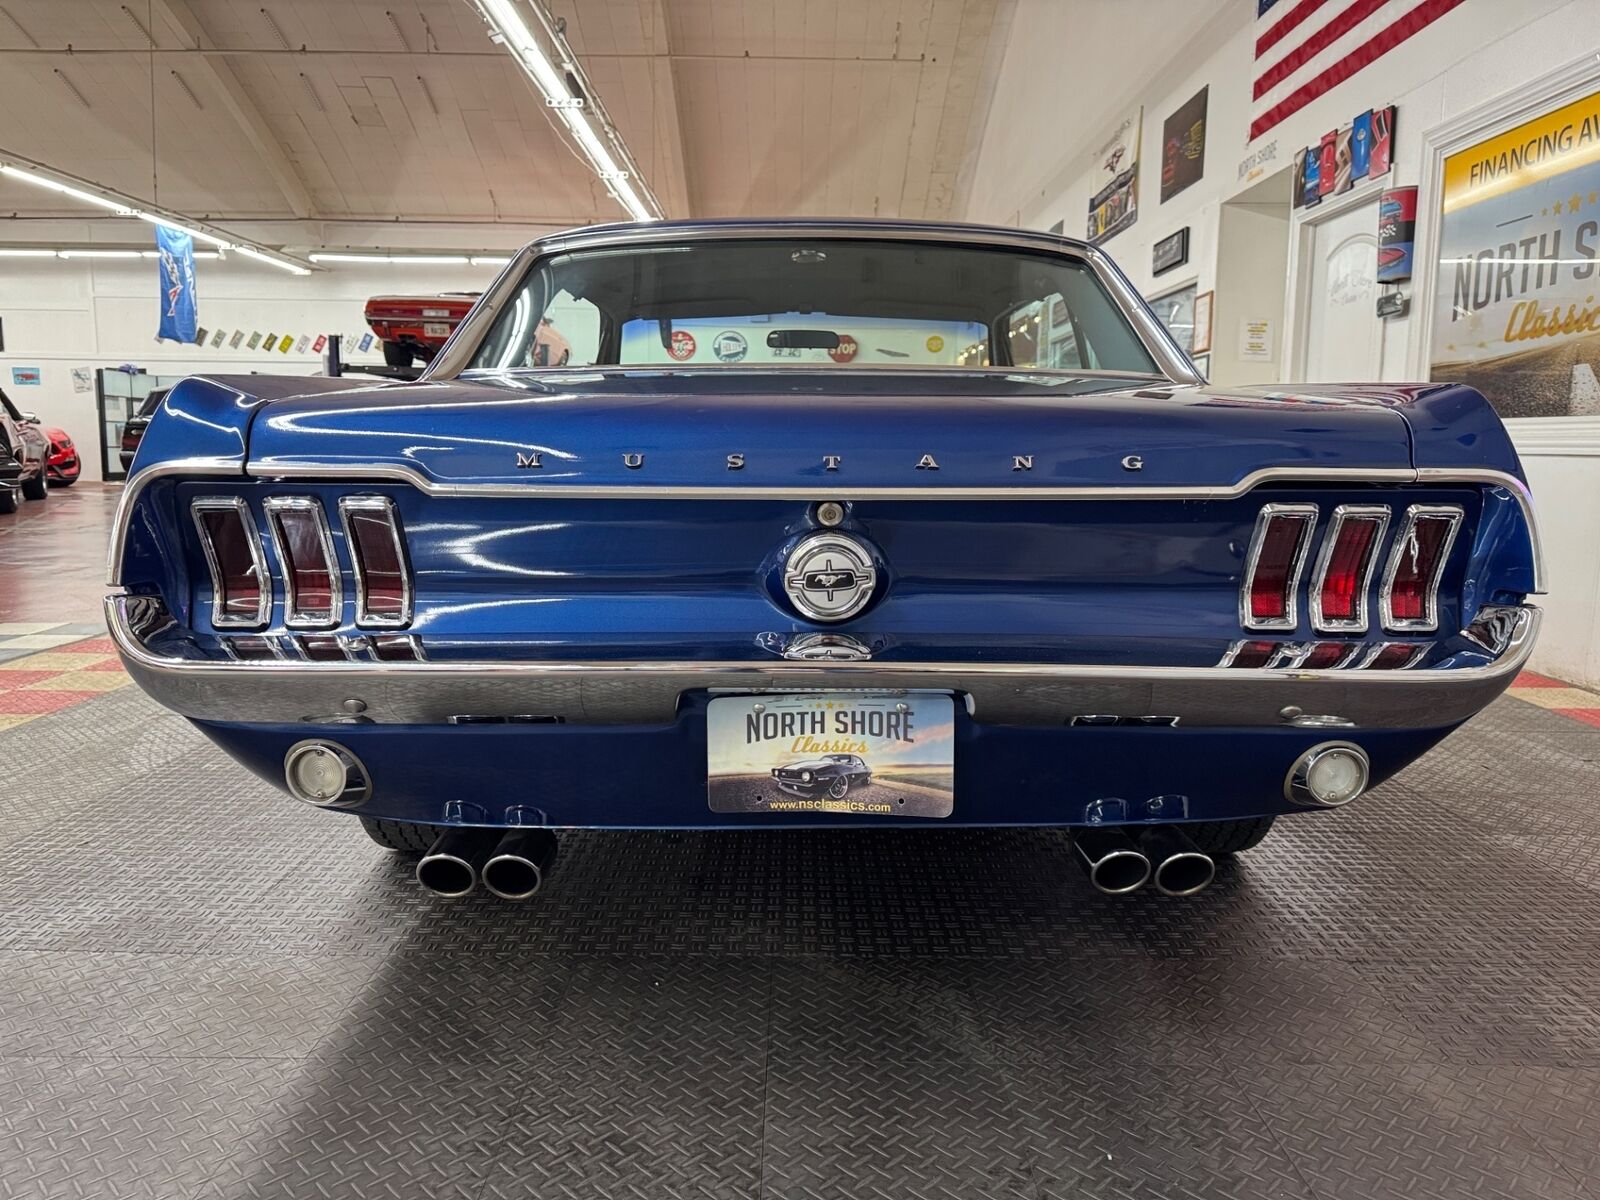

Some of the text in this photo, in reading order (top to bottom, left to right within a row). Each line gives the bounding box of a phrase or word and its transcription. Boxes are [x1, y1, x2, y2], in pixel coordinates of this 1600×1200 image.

[1470, 124, 1573, 188] FINANCING
[1452, 229, 1562, 322] NORTH
[1573, 220, 1600, 280] S
[516, 452, 1144, 471] MUSTANG
[747, 710, 915, 744] NORTH SHORE
[791, 735, 868, 754] Classics
[770, 799, 891, 813] www.nsclassics.com
